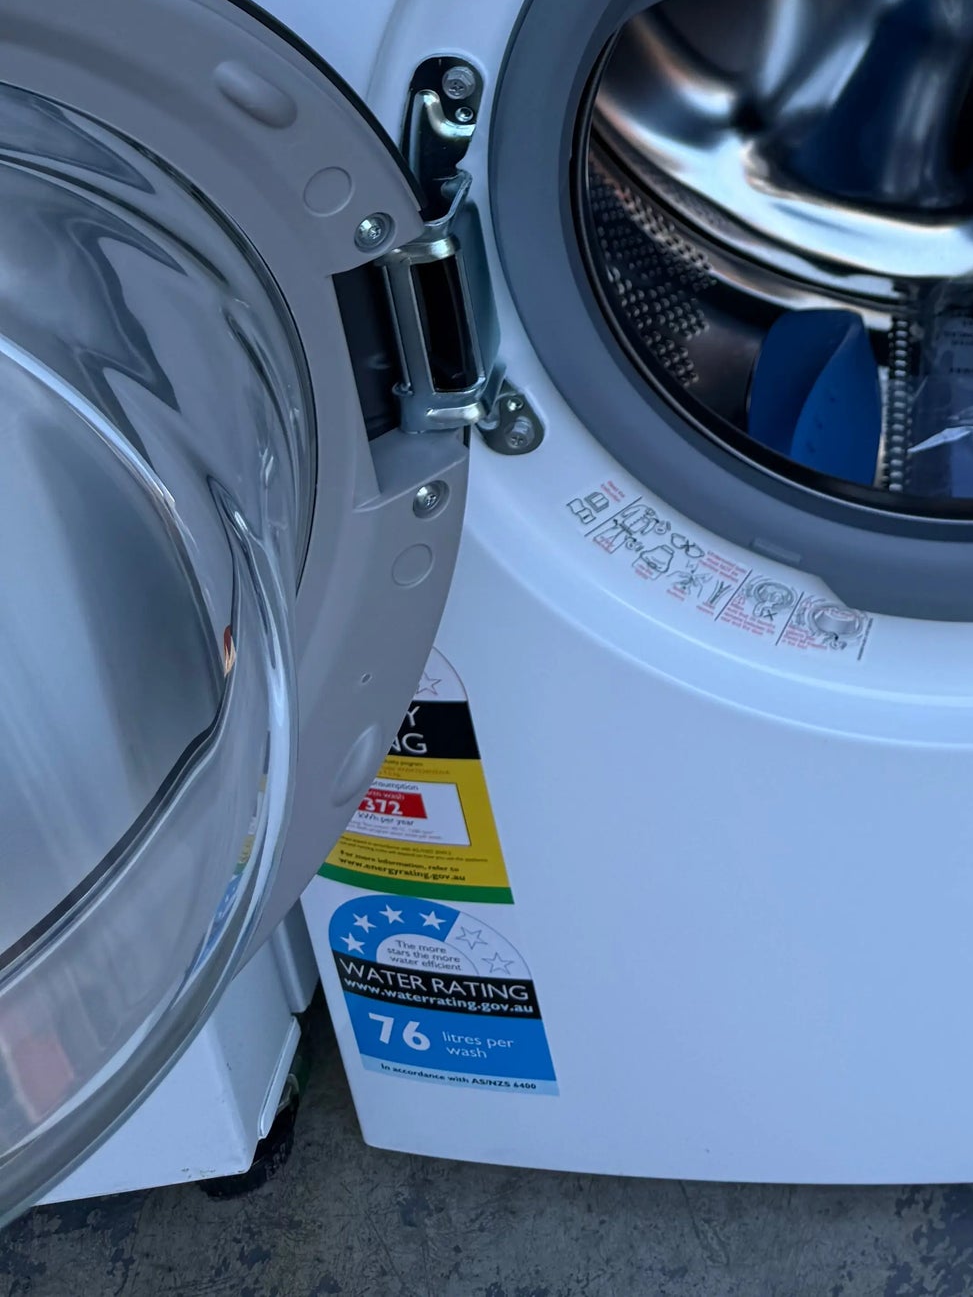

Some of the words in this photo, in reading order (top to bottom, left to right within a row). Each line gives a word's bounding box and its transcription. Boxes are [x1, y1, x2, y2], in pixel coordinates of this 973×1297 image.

[364, 798, 403, 816] 372
[387, 947, 411, 957] stars
[413, 950, 430, 959] the
[432, 954, 461, 963] more
[395, 939, 415, 950] The
[418, 945, 447, 954] more
[389, 956, 418, 966] water
[421, 961, 462, 971] efficient
[339, 958, 427, 992] WATER
[431, 977, 529, 1001] RATING
[343, 977, 534, 1014] www.waterrating.gov.au
[368, 1012, 431, 1051] 76
[442, 1031, 482, 1047] litres
[486, 1037, 515, 1050] per
[446, 1046, 488, 1059] wash
[393, 1067, 445, 1081] accordance
[447, 1076, 470, 1084] with
